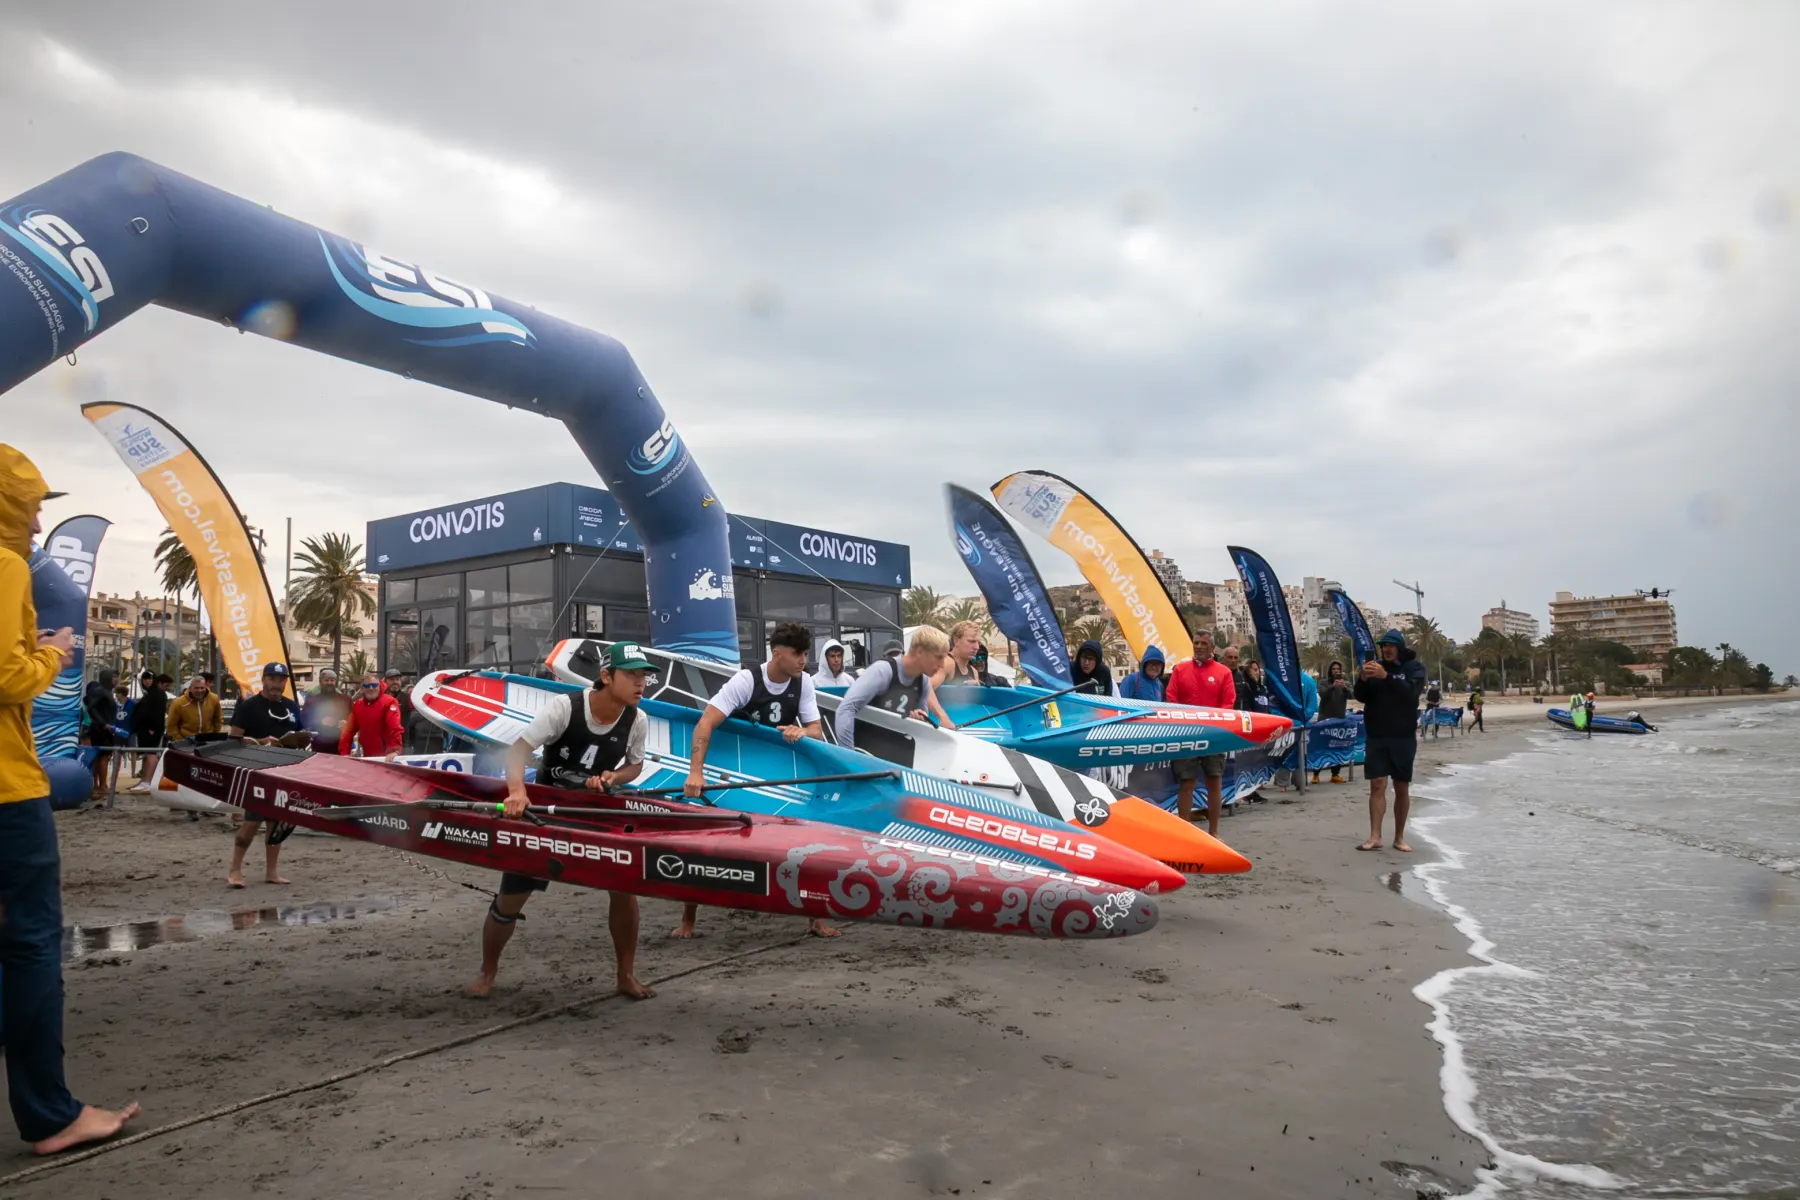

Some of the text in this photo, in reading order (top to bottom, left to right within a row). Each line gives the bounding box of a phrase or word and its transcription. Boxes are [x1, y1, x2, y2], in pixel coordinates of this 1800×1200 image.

[0, 244, 66, 333] ROPEAN SUP LEAGUE
[8, 262, 42, 301] EUROPEAN
[37, 299, 56, 330] SURFING
[409, 501, 505, 543] CONVOTIS
[799, 532, 877, 566] CONVOTIS
[972, 522, 1066, 674] EUROPEAN SUP LEAGUE
[1258, 571, 1273, 610] LEAGUE
[1269, 611, 1278, 630] SUP
[768, 701, 782, 723] 3
[896, 694, 909, 713] 2
[580, 744, 599, 769] 4
[444, 825, 488, 842] WAKAO
